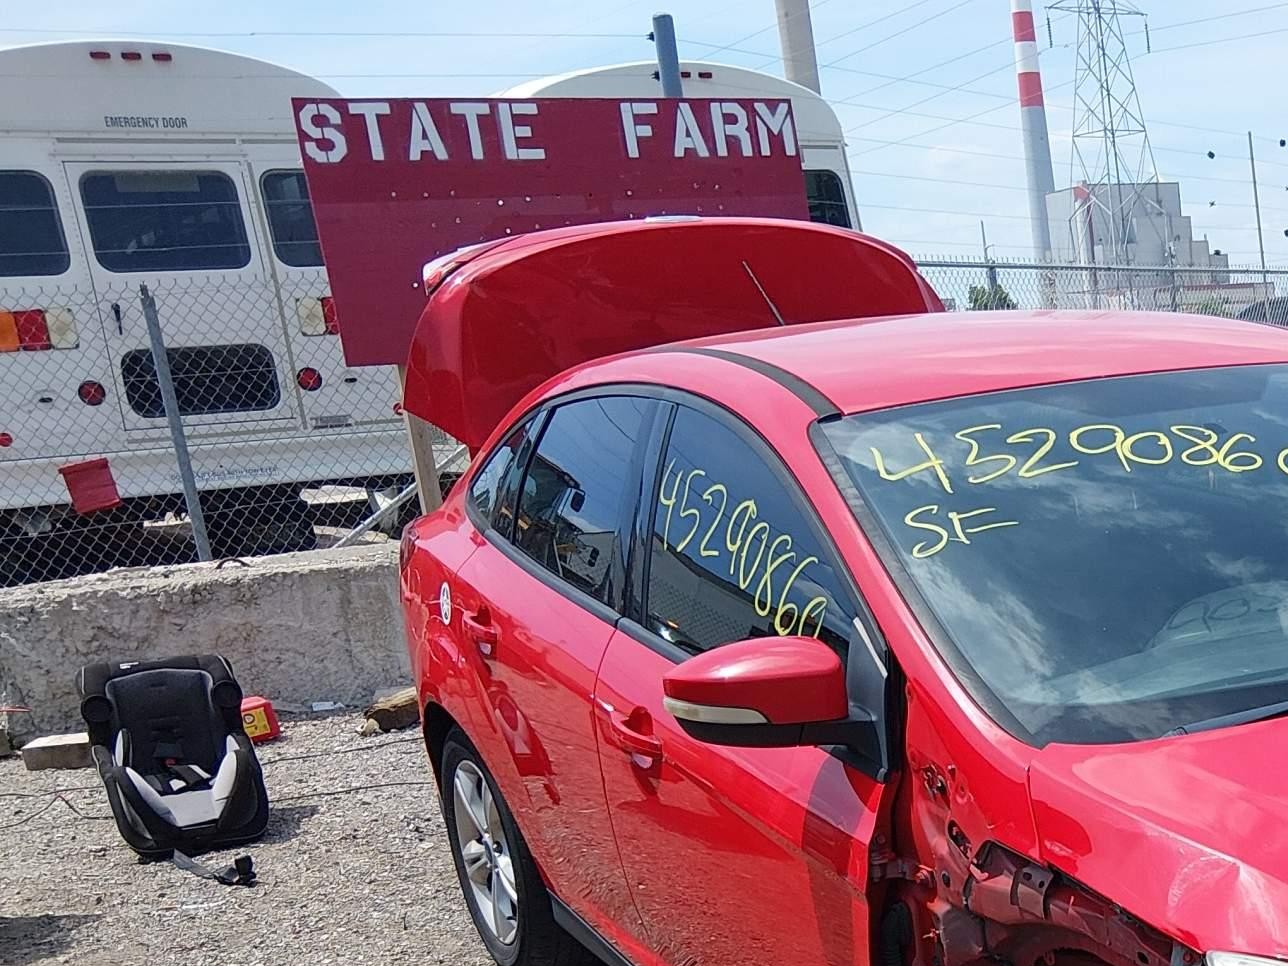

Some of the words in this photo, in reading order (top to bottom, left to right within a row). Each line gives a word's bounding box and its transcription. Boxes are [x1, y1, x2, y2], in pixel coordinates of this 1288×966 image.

[104, 115, 160, 129] EMERGENCY
[161, 116, 189, 129] DOOR
[298, 102, 546, 163] STATE
[619, 102, 797, 159] FARM
[903, 504, 1020, 559] SF
